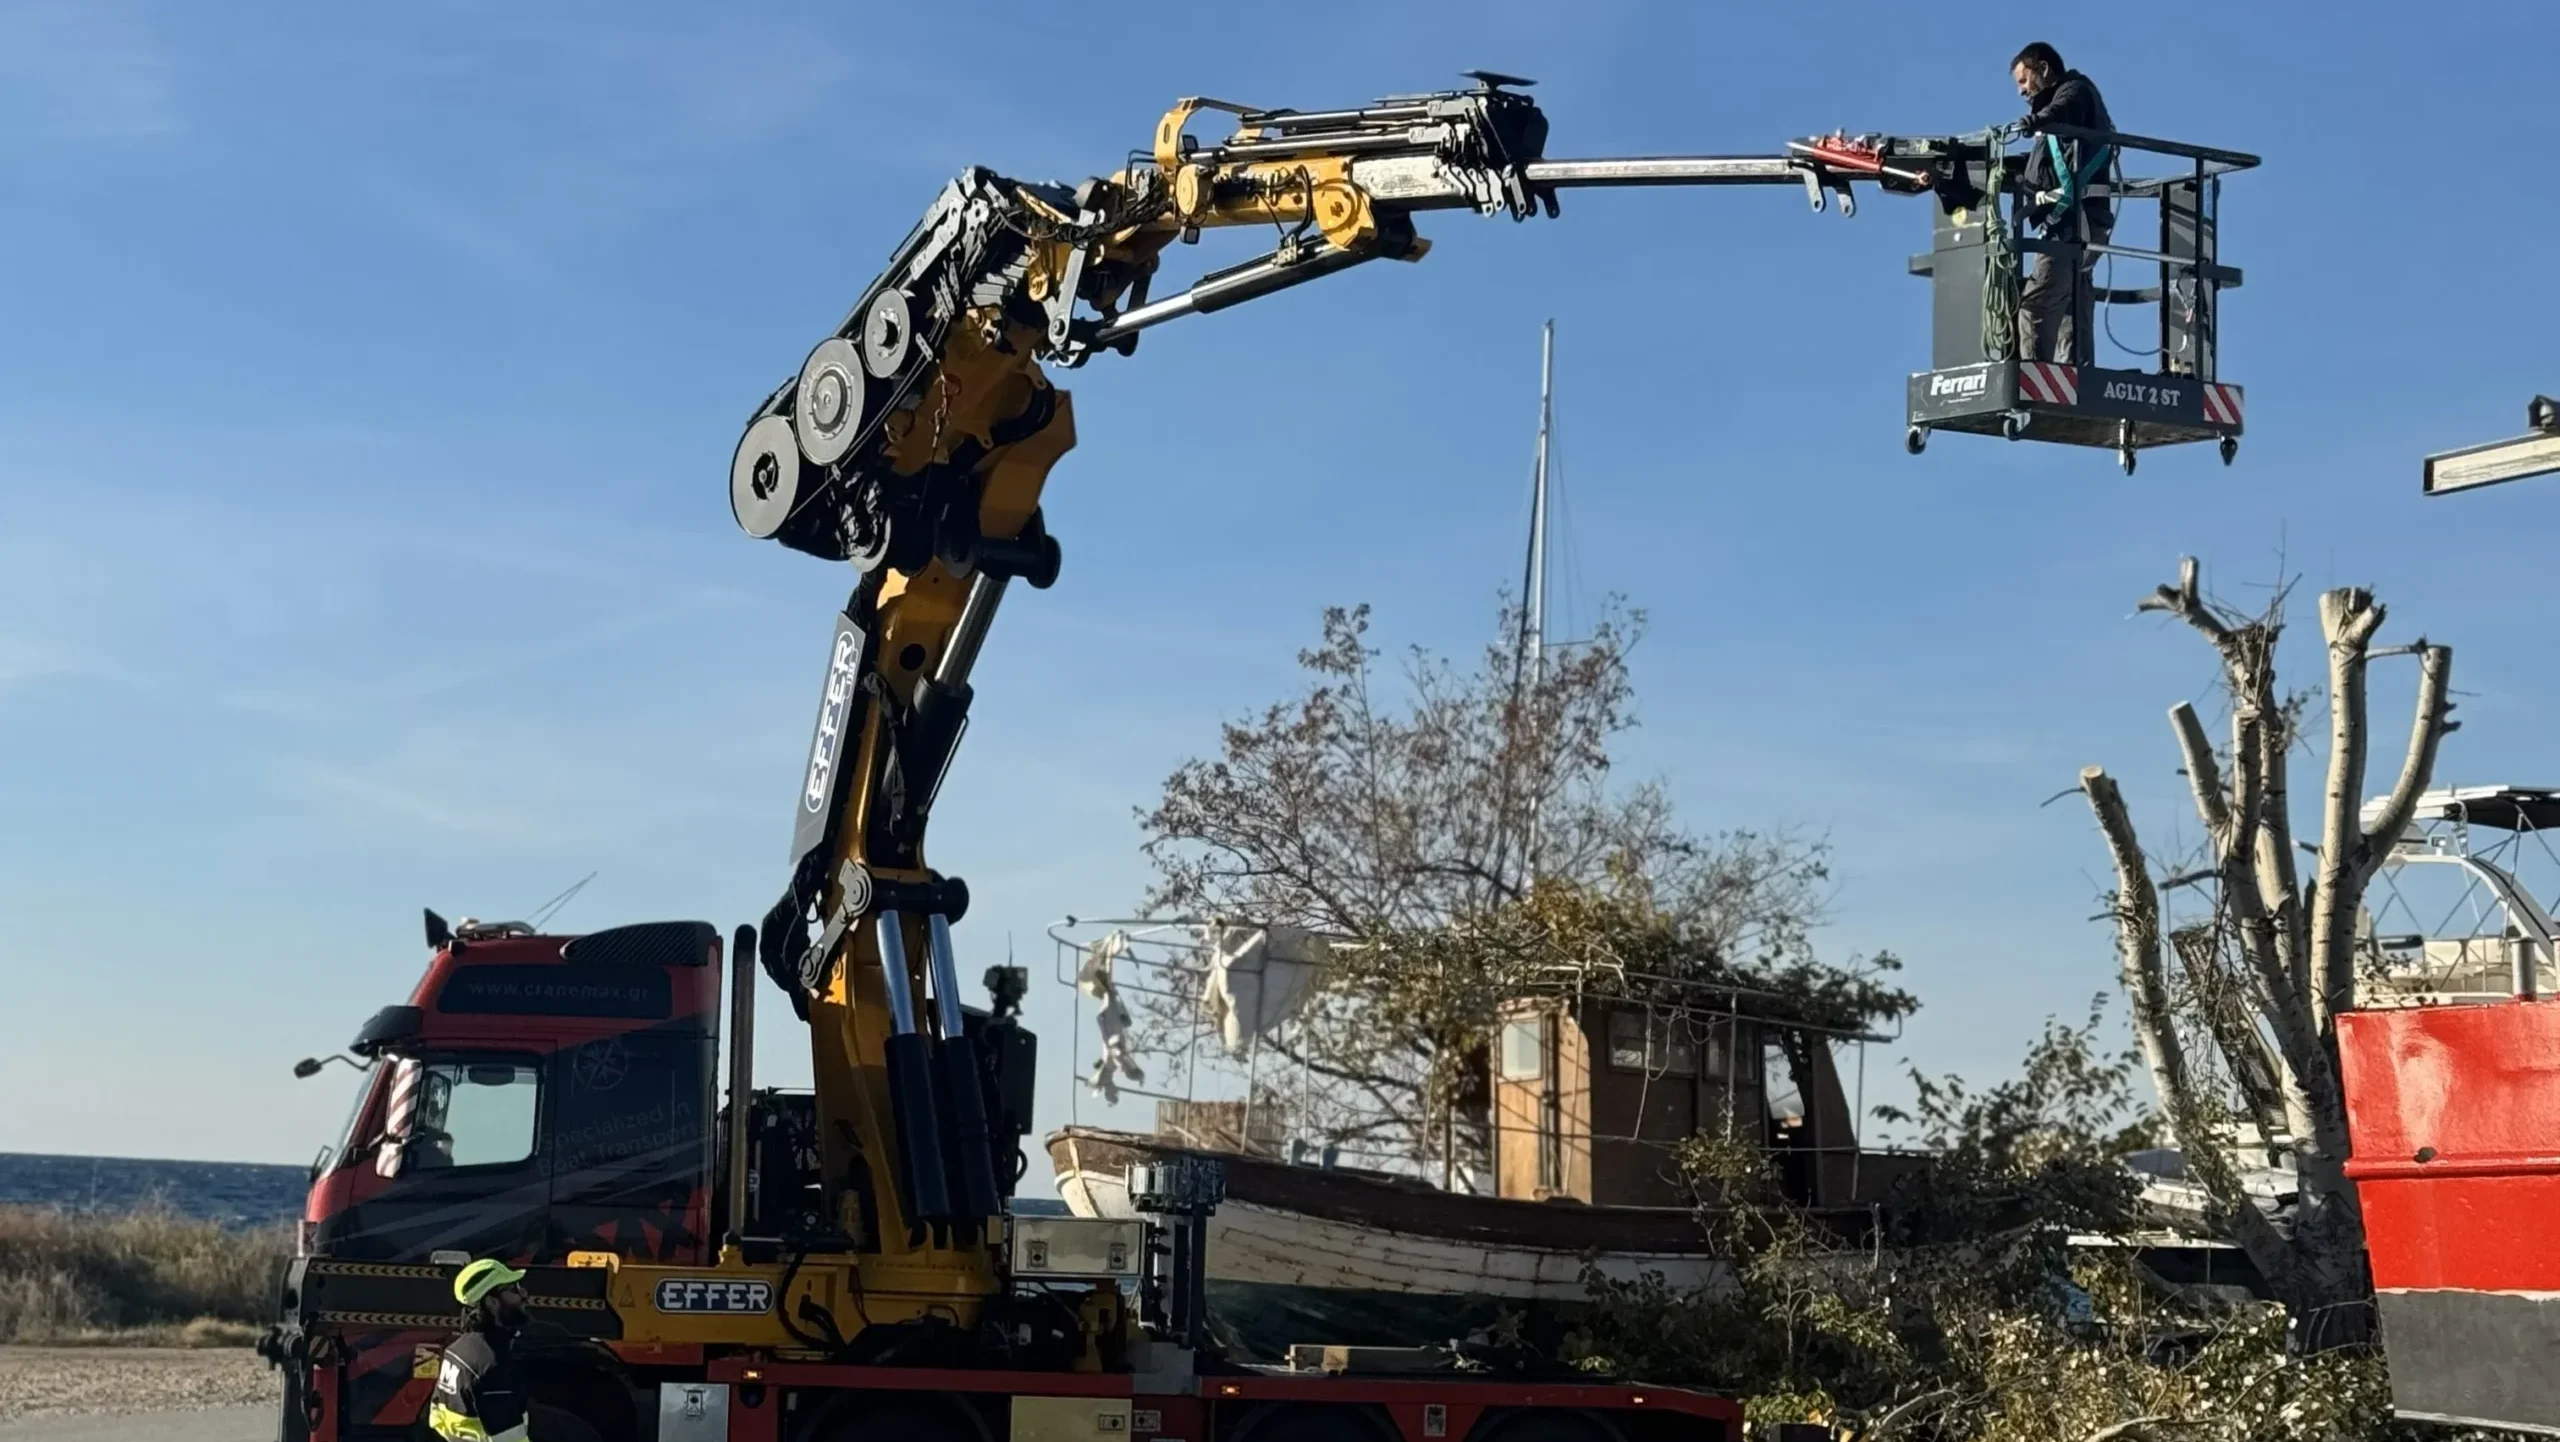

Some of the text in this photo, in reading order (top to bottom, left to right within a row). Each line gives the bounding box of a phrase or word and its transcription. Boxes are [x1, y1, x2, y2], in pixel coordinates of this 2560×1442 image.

[1930, 369, 1988, 396] Ferrari
[2103, 381, 2181, 406] AGLY 2 ST
[808, 640, 853, 802] EFFER
[467, 979, 650, 1001] www.cranemax.gr
[661, 1282, 769, 1310] EFFER
